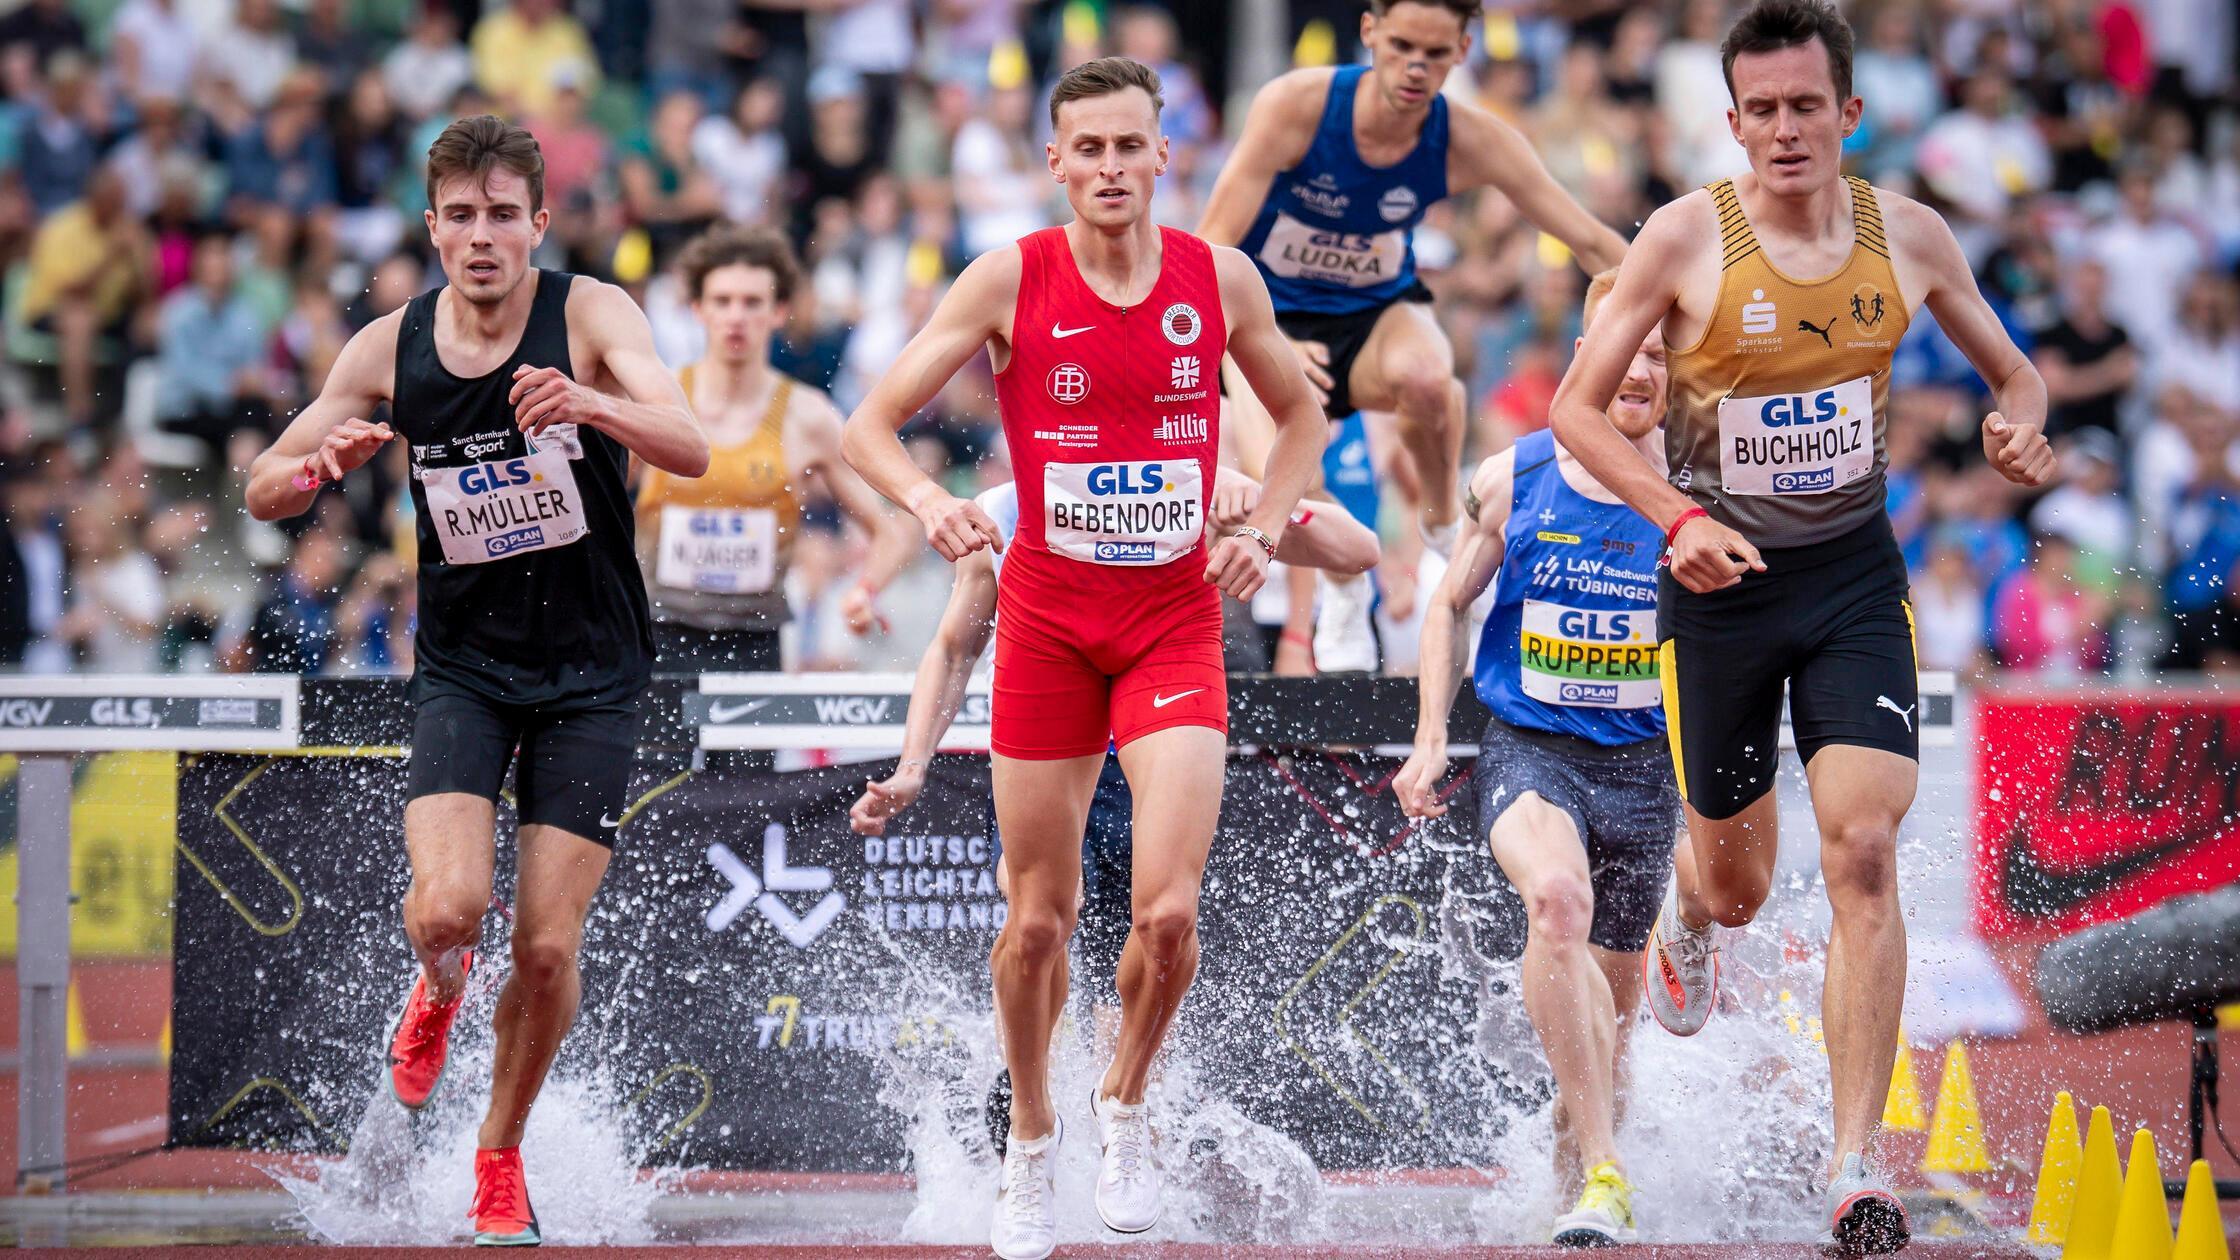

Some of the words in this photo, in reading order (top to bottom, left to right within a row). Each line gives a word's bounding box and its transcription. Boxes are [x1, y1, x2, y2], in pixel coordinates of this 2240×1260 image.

[1282, 244, 1382, 276] LUDKA
[1736, 337, 1783, 347] Sparkasse
[1154, 391, 1207, 403] BUNDESWEHR
[1760, 390, 1849, 428] GLS.
[452, 436, 474, 446] Sanct
[475, 428, 510, 442] Bernhard
[1163, 413, 1207, 442] hillig
[464, 439, 505, 458] Sport
[1735, 420, 1862, 465] BUCHHOLZ
[458, 459, 544, 496] GLS.
[1087, 463, 1175, 496] GLS.
[1798, 471, 1832, 484] PLAN
[445, 489, 571, 537] R.MÜLLER
[1054, 499, 1196, 534] BEBENDORF
[509, 530, 541, 544] PLAN
[1120, 545, 1152, 554] PLAN
[1566, 558, 1603, 574] LAV
[1603, 566, 1658, 583] Stadtwerk
[1565, 576, 1659, 602] TÜBINGEN
[1558, 610, 1641, 641] GLS.
[1527, 636, 1660, 676] RUPPERT
[1583, 687, 1616, 698] PLAN
[814, 696, 890, 723] WGV
[864, 835, 989, 865] DEUTSC
[864, 867, 997, 897] LEICHTA
[863, 902, 1009, 930] VERBAND
